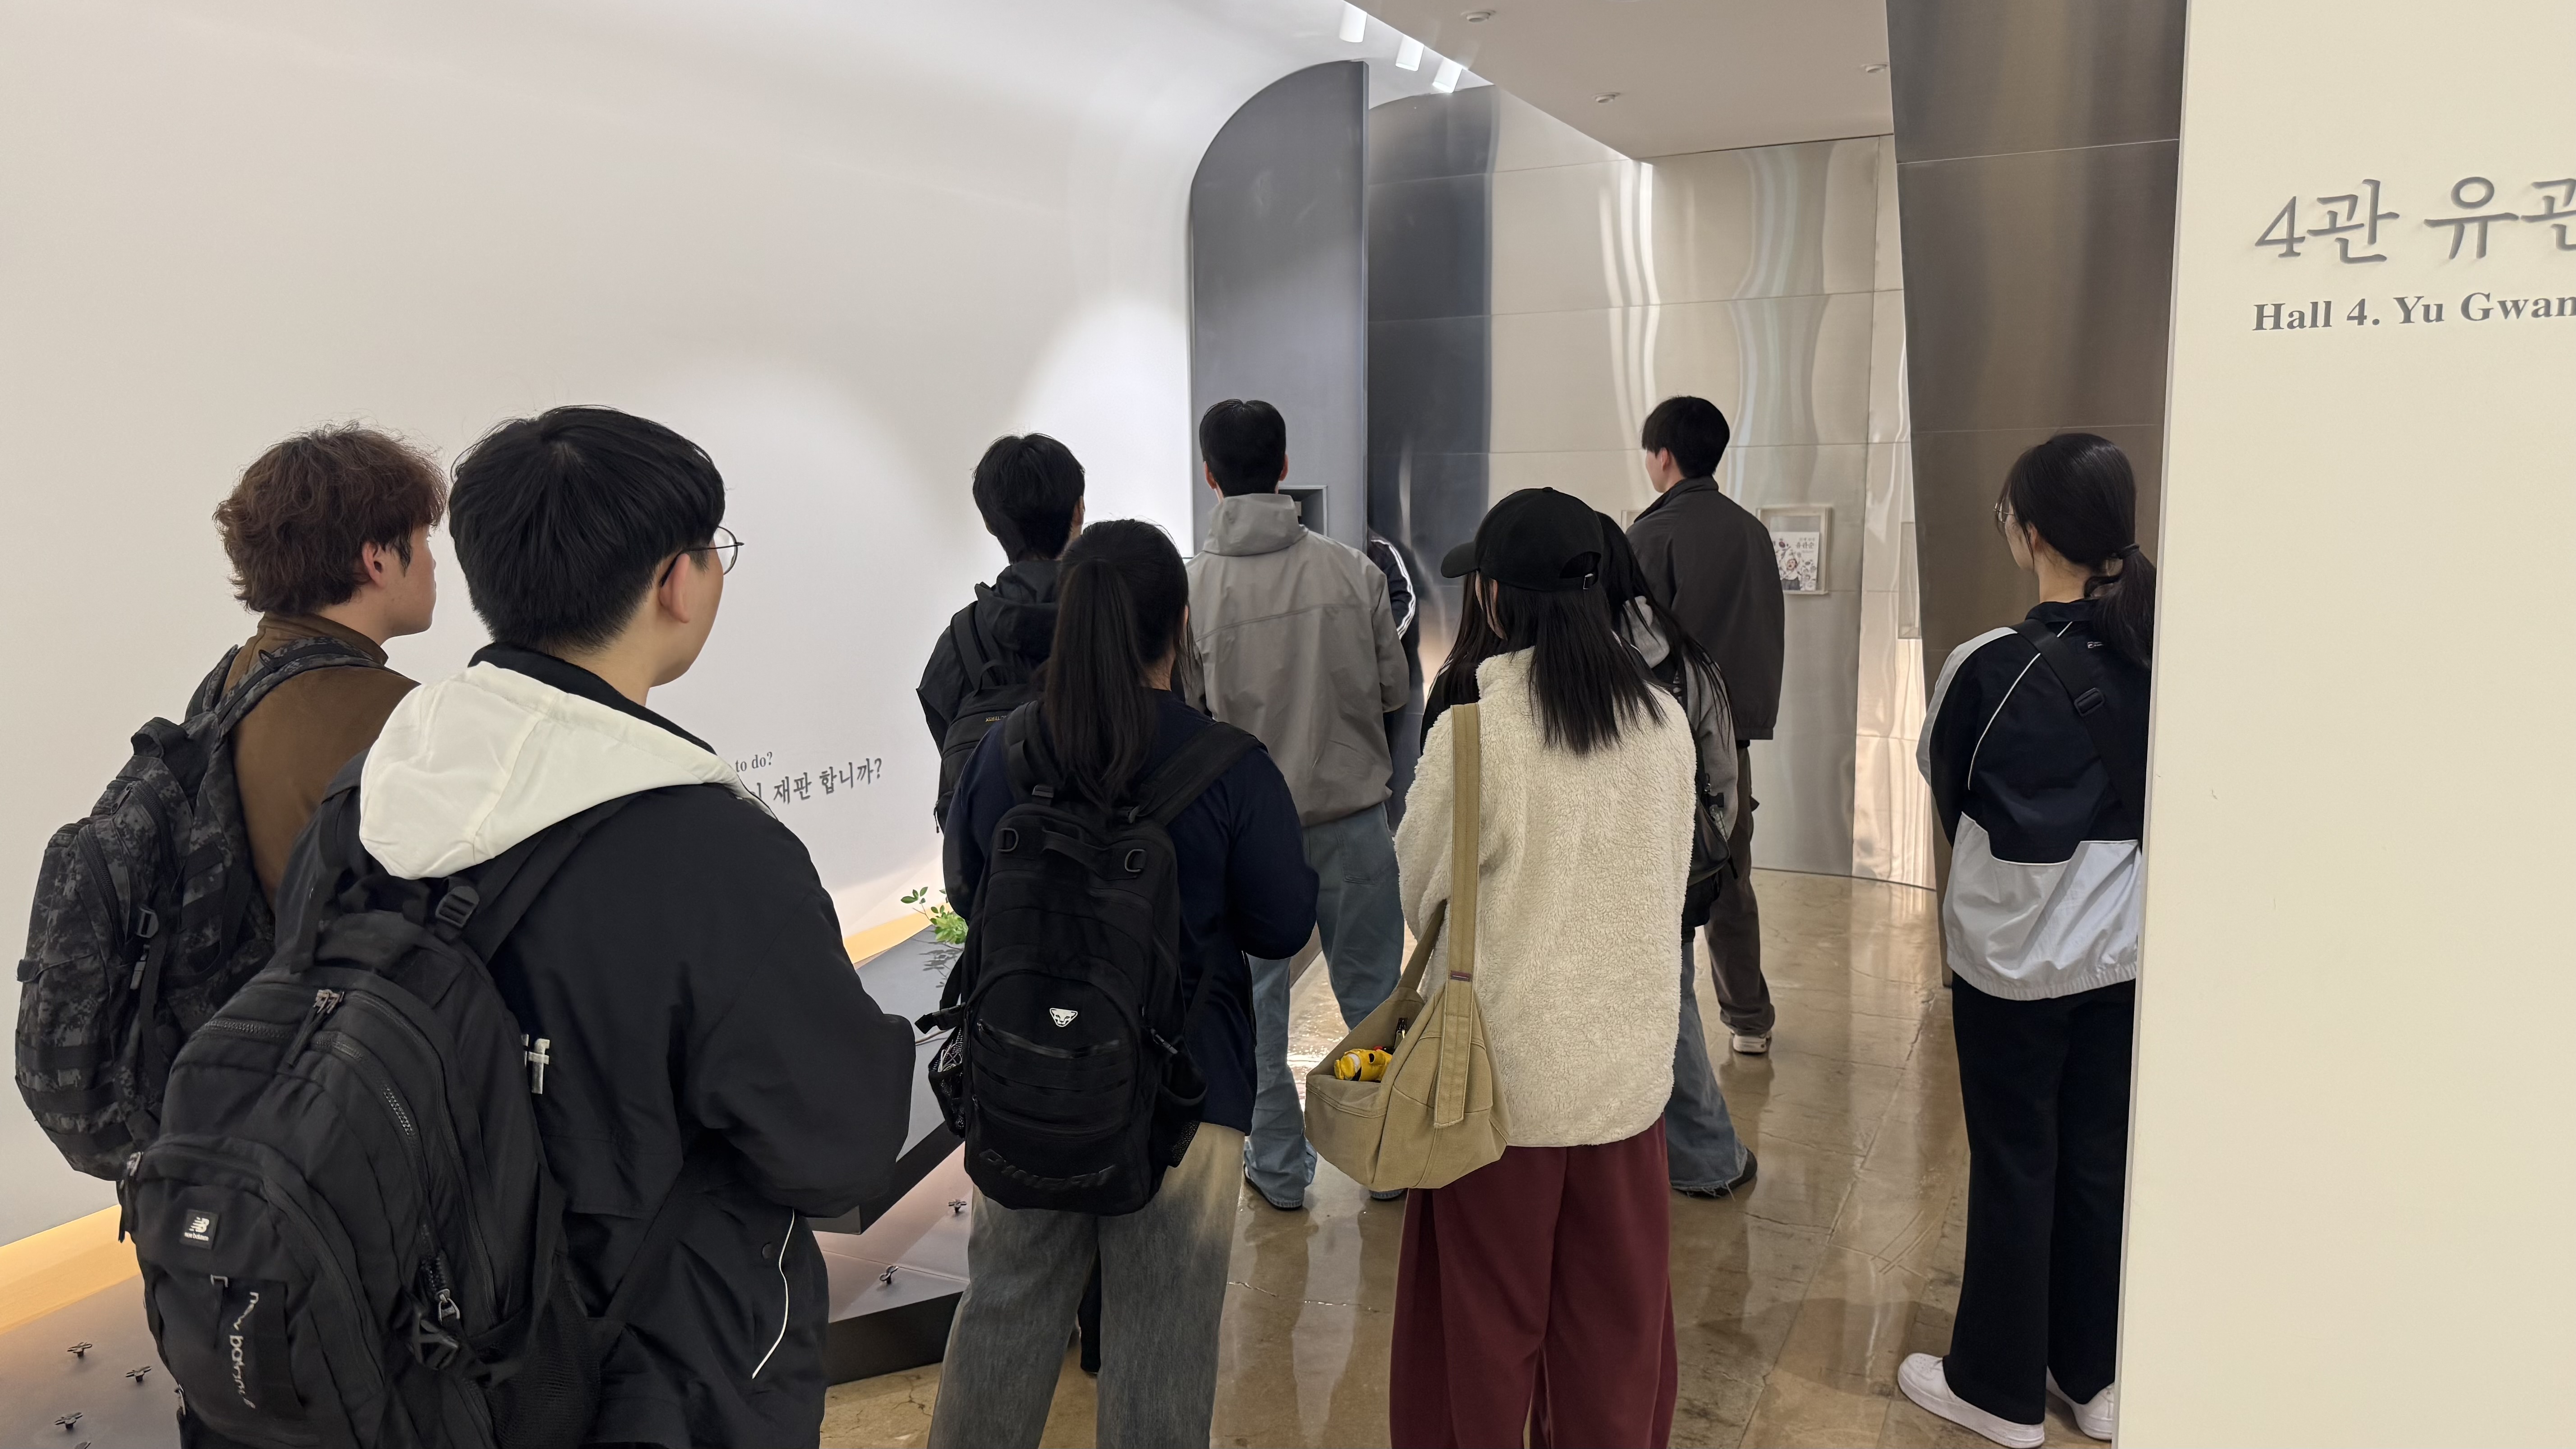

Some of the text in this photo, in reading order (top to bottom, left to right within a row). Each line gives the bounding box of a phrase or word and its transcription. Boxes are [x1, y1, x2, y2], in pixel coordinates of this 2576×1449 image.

[2255, 179, 2400, 264] 4관
[2252, 300, 2332, 331] Hall
[2346, 298, 2380, 326] 4.
[2393, 296, 2445, 324] Yu
[735, 751, 773, 773] to do?
[773, 772, 812, 804] 재판
[819, 758, 882, 795] 합니까?
